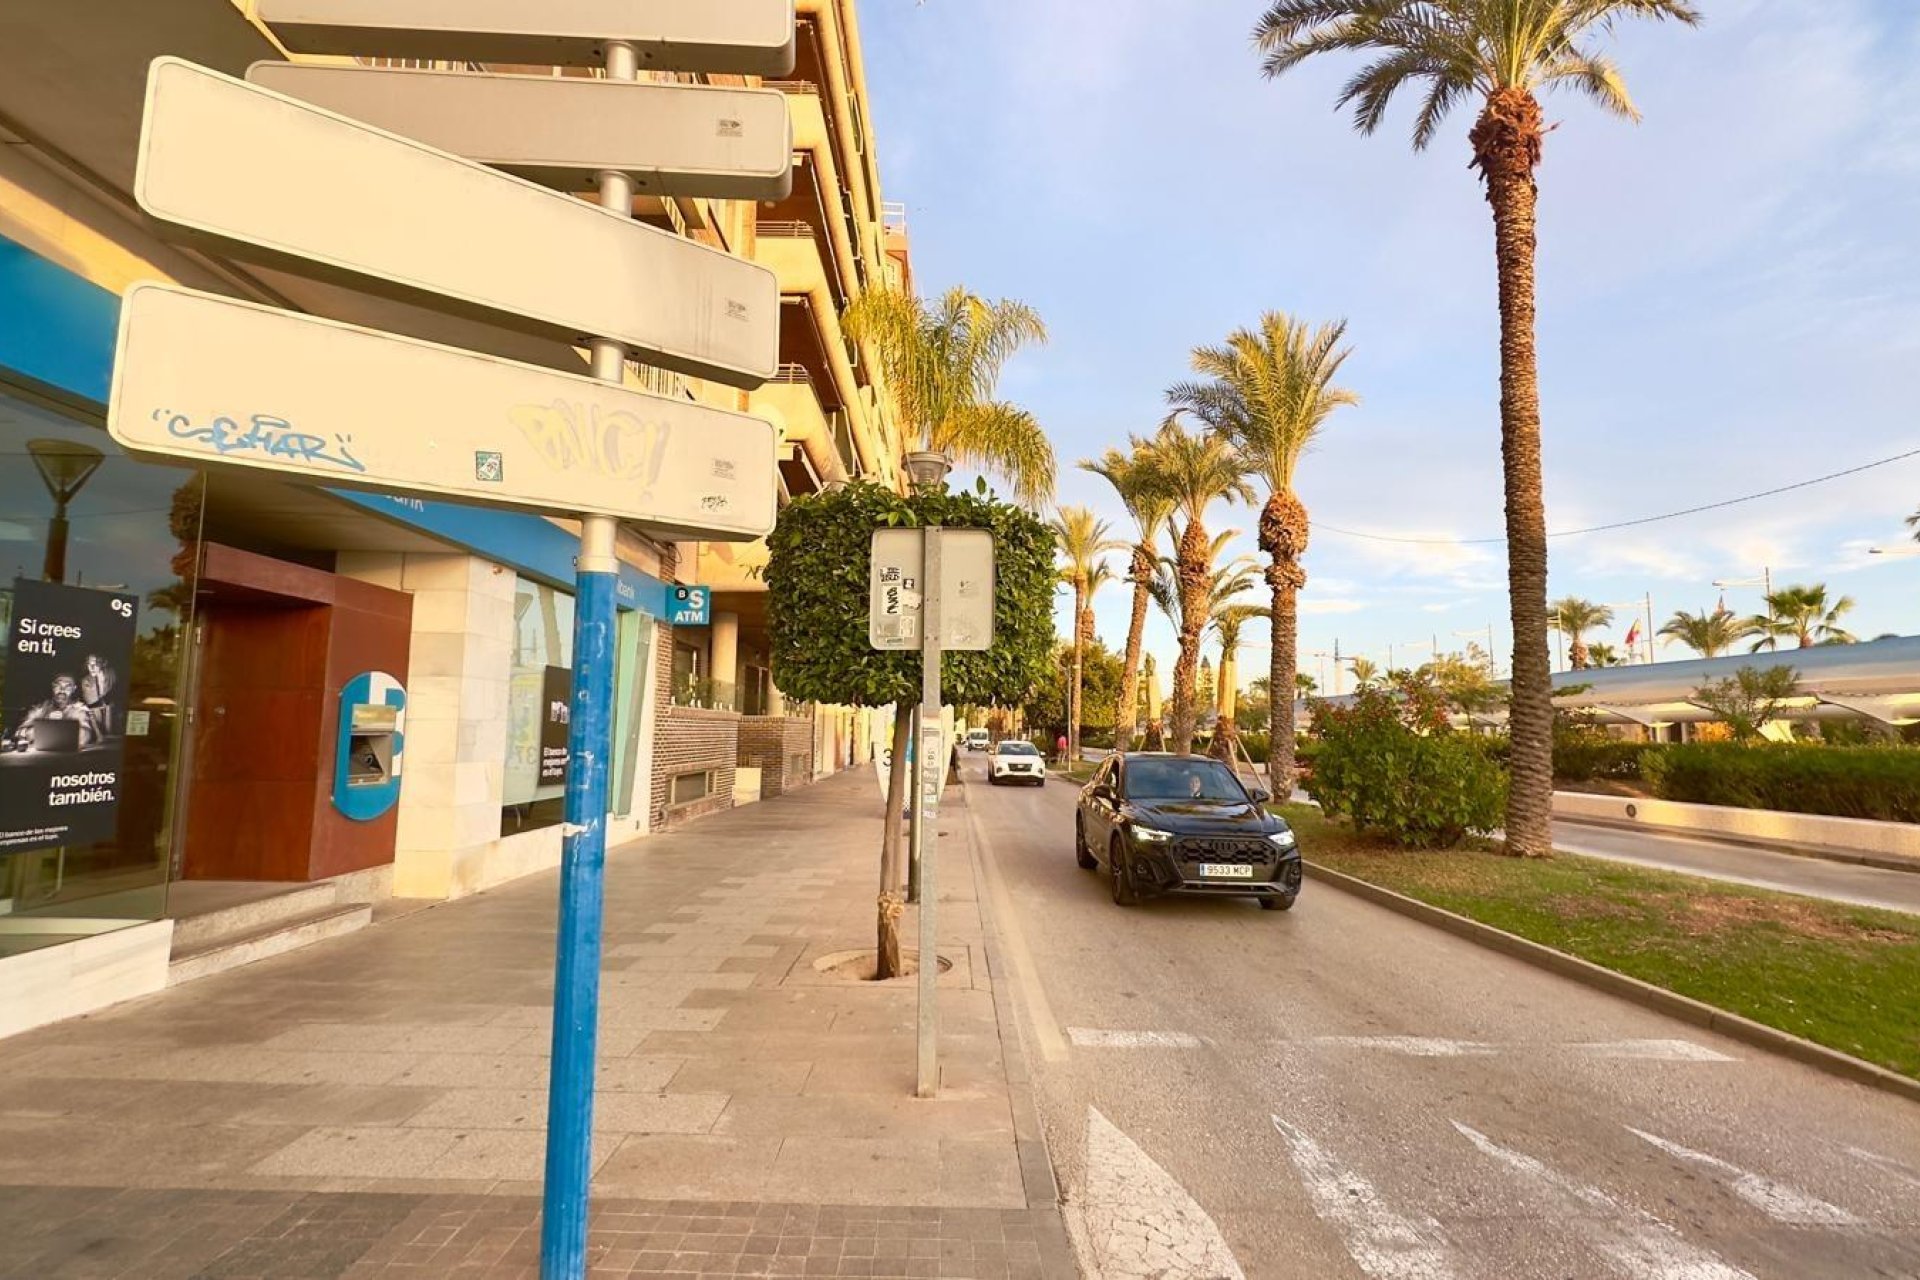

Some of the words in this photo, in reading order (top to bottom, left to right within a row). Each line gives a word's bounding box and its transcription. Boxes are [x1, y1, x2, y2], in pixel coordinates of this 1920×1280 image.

[674, 611, 703, 622] ATM
[19, 618, 37, 635] Si
[38, 623, 82, 639] crees
[18, 639, 40, 652] en
[42, 638, 56, 656] ti,
[51, 771, 115, 787] nosotros
[49, 788, 115, 806] también.
[1207, 865, 1231, 876] 9533
